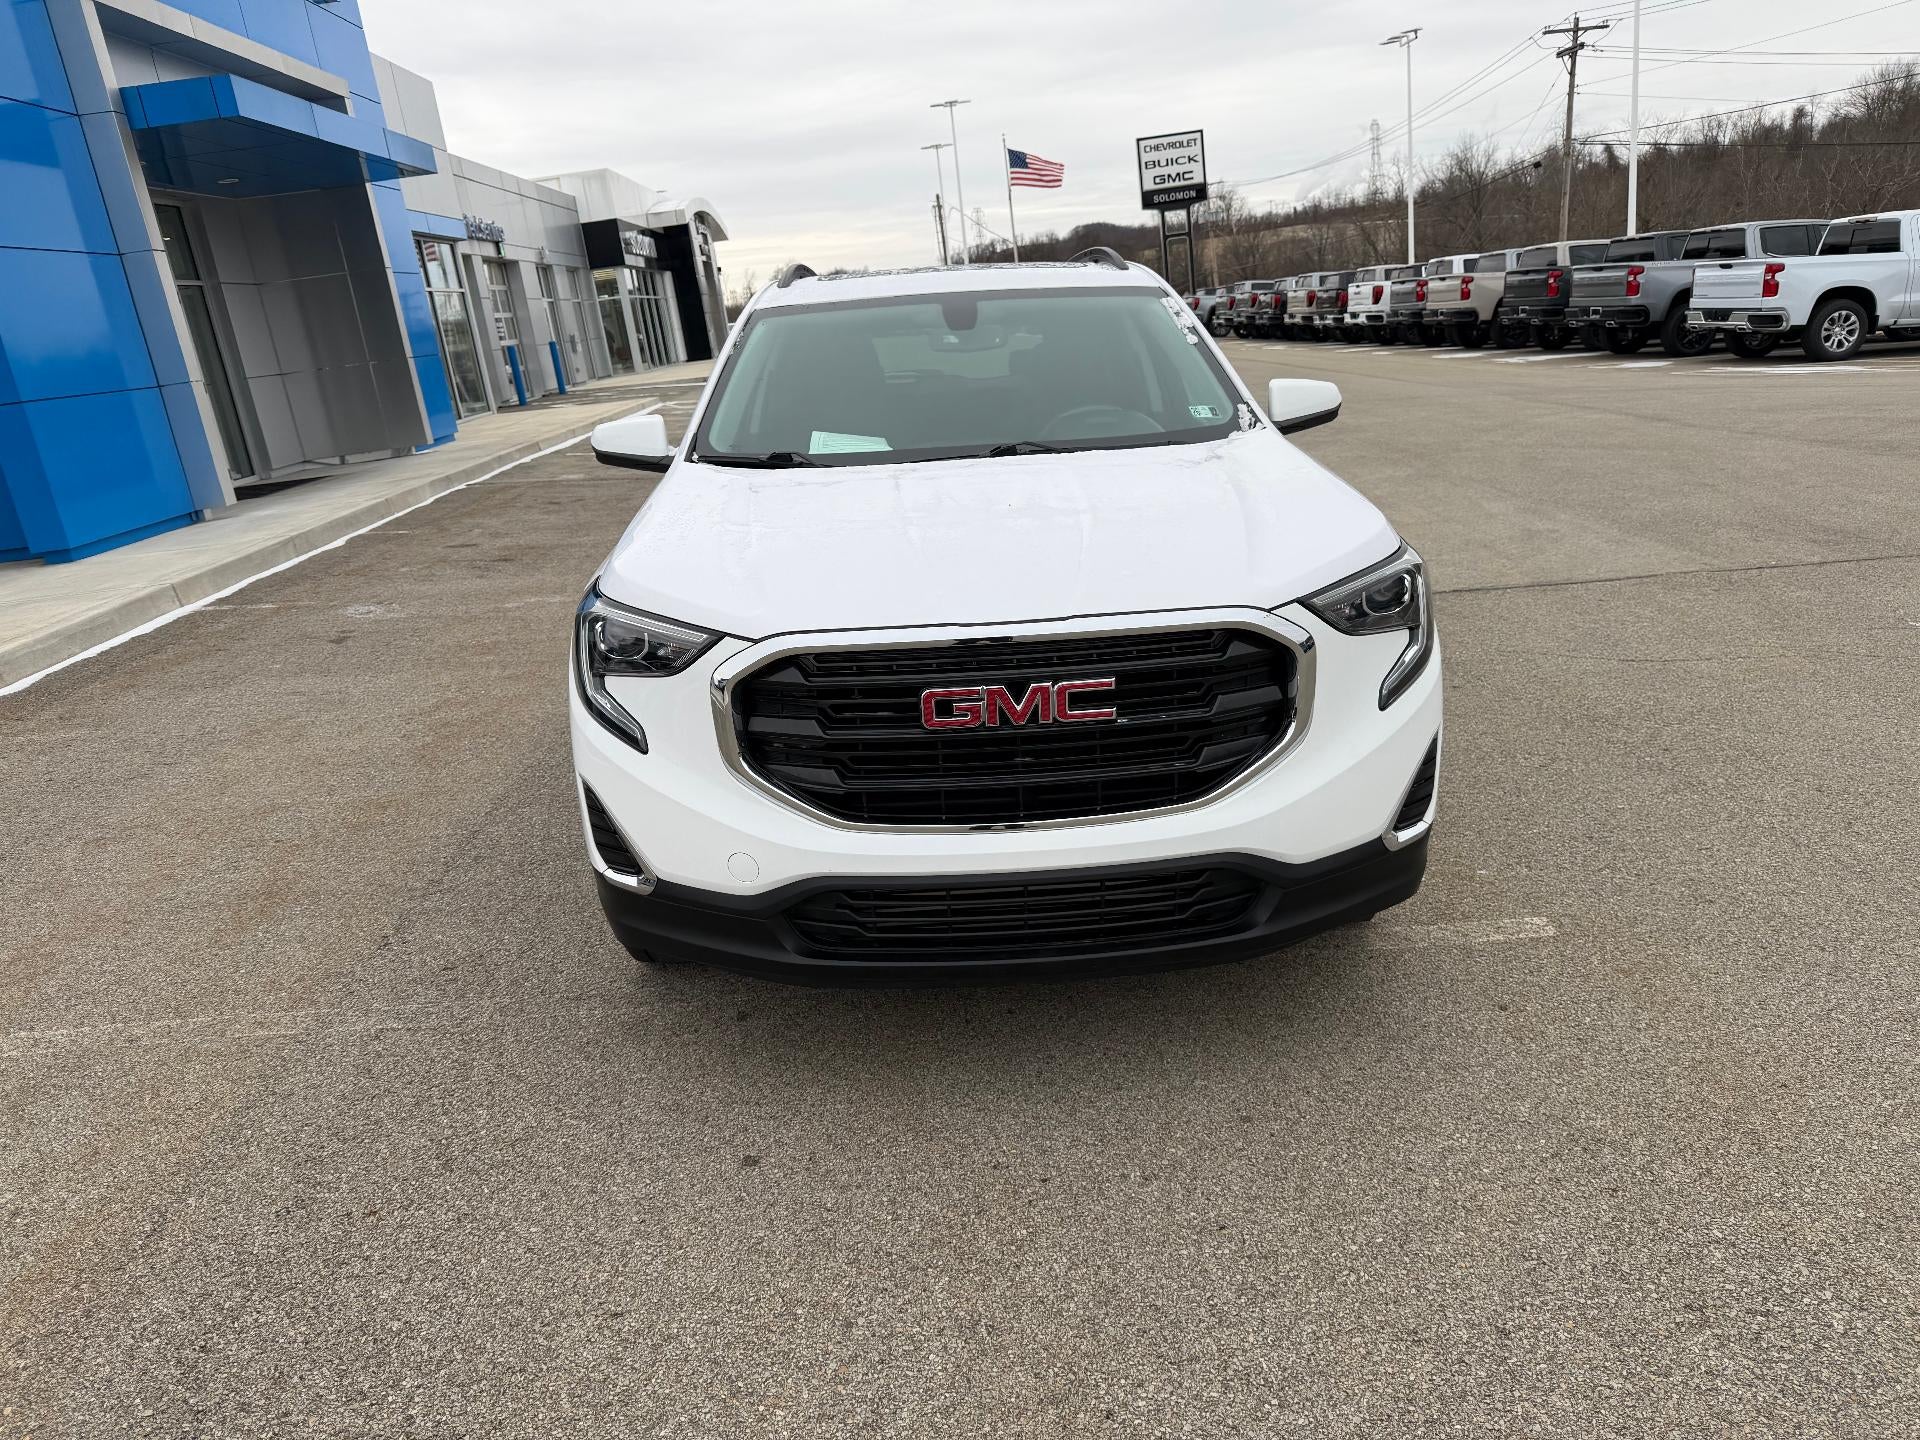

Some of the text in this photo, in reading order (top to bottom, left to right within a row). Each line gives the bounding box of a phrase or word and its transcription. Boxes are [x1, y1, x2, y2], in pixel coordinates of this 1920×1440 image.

[1143, 138, 1198, 154] CHEVROLET
[1144, 154, 1200, 170] BUICK
[1153, 170, 1194, 186] GMC
[1153, 190, 1197, 204] SOLOMON
[920, 677, 1117, 729] GMC
